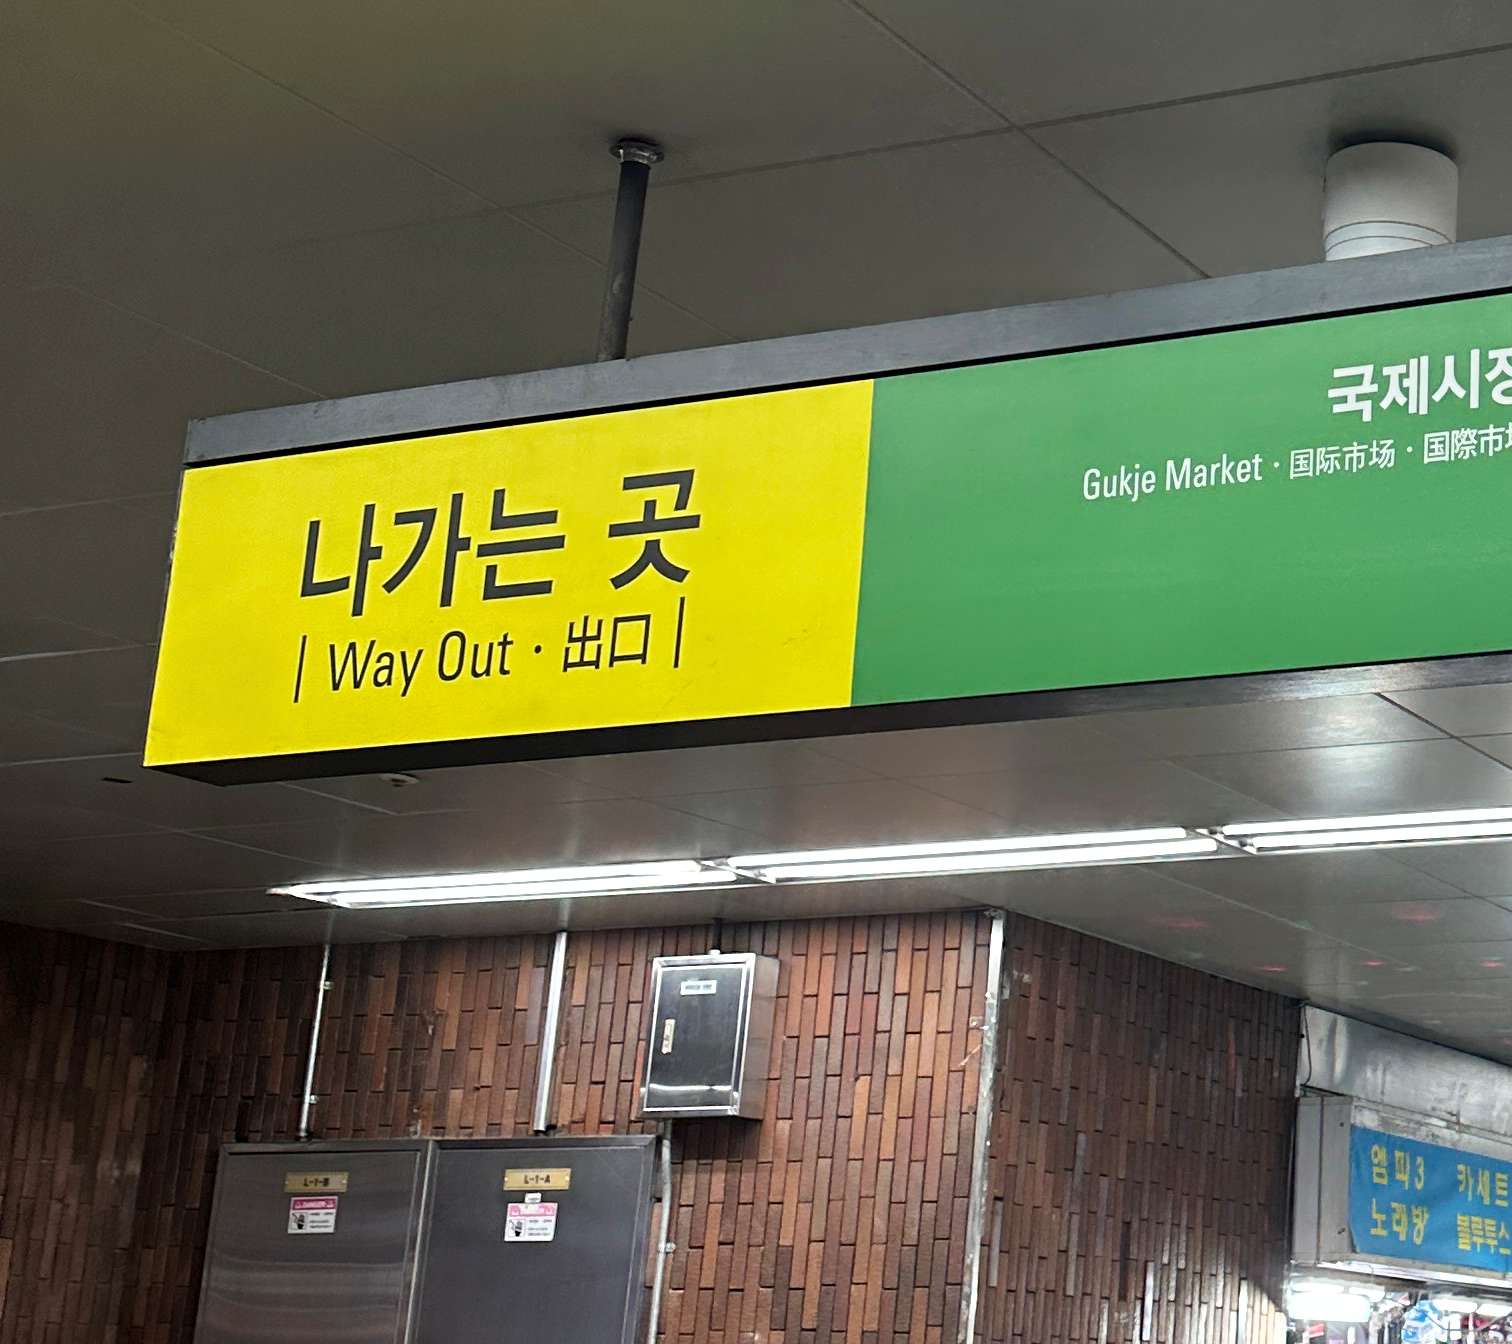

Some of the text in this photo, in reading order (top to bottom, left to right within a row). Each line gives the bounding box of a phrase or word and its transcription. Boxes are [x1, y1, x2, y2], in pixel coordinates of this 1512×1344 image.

[1083, 463, 1156, 503] Gukje
[1165, 453, 1263, 491] Market
[1289, 439, 1396, 480] 国际市场
[300, 469, 701, 618] 나가는 곳
[329, 613, 651, 698] Way Out 出口
[1370, 1198, 1511, 1255] 노래방 블루투스
